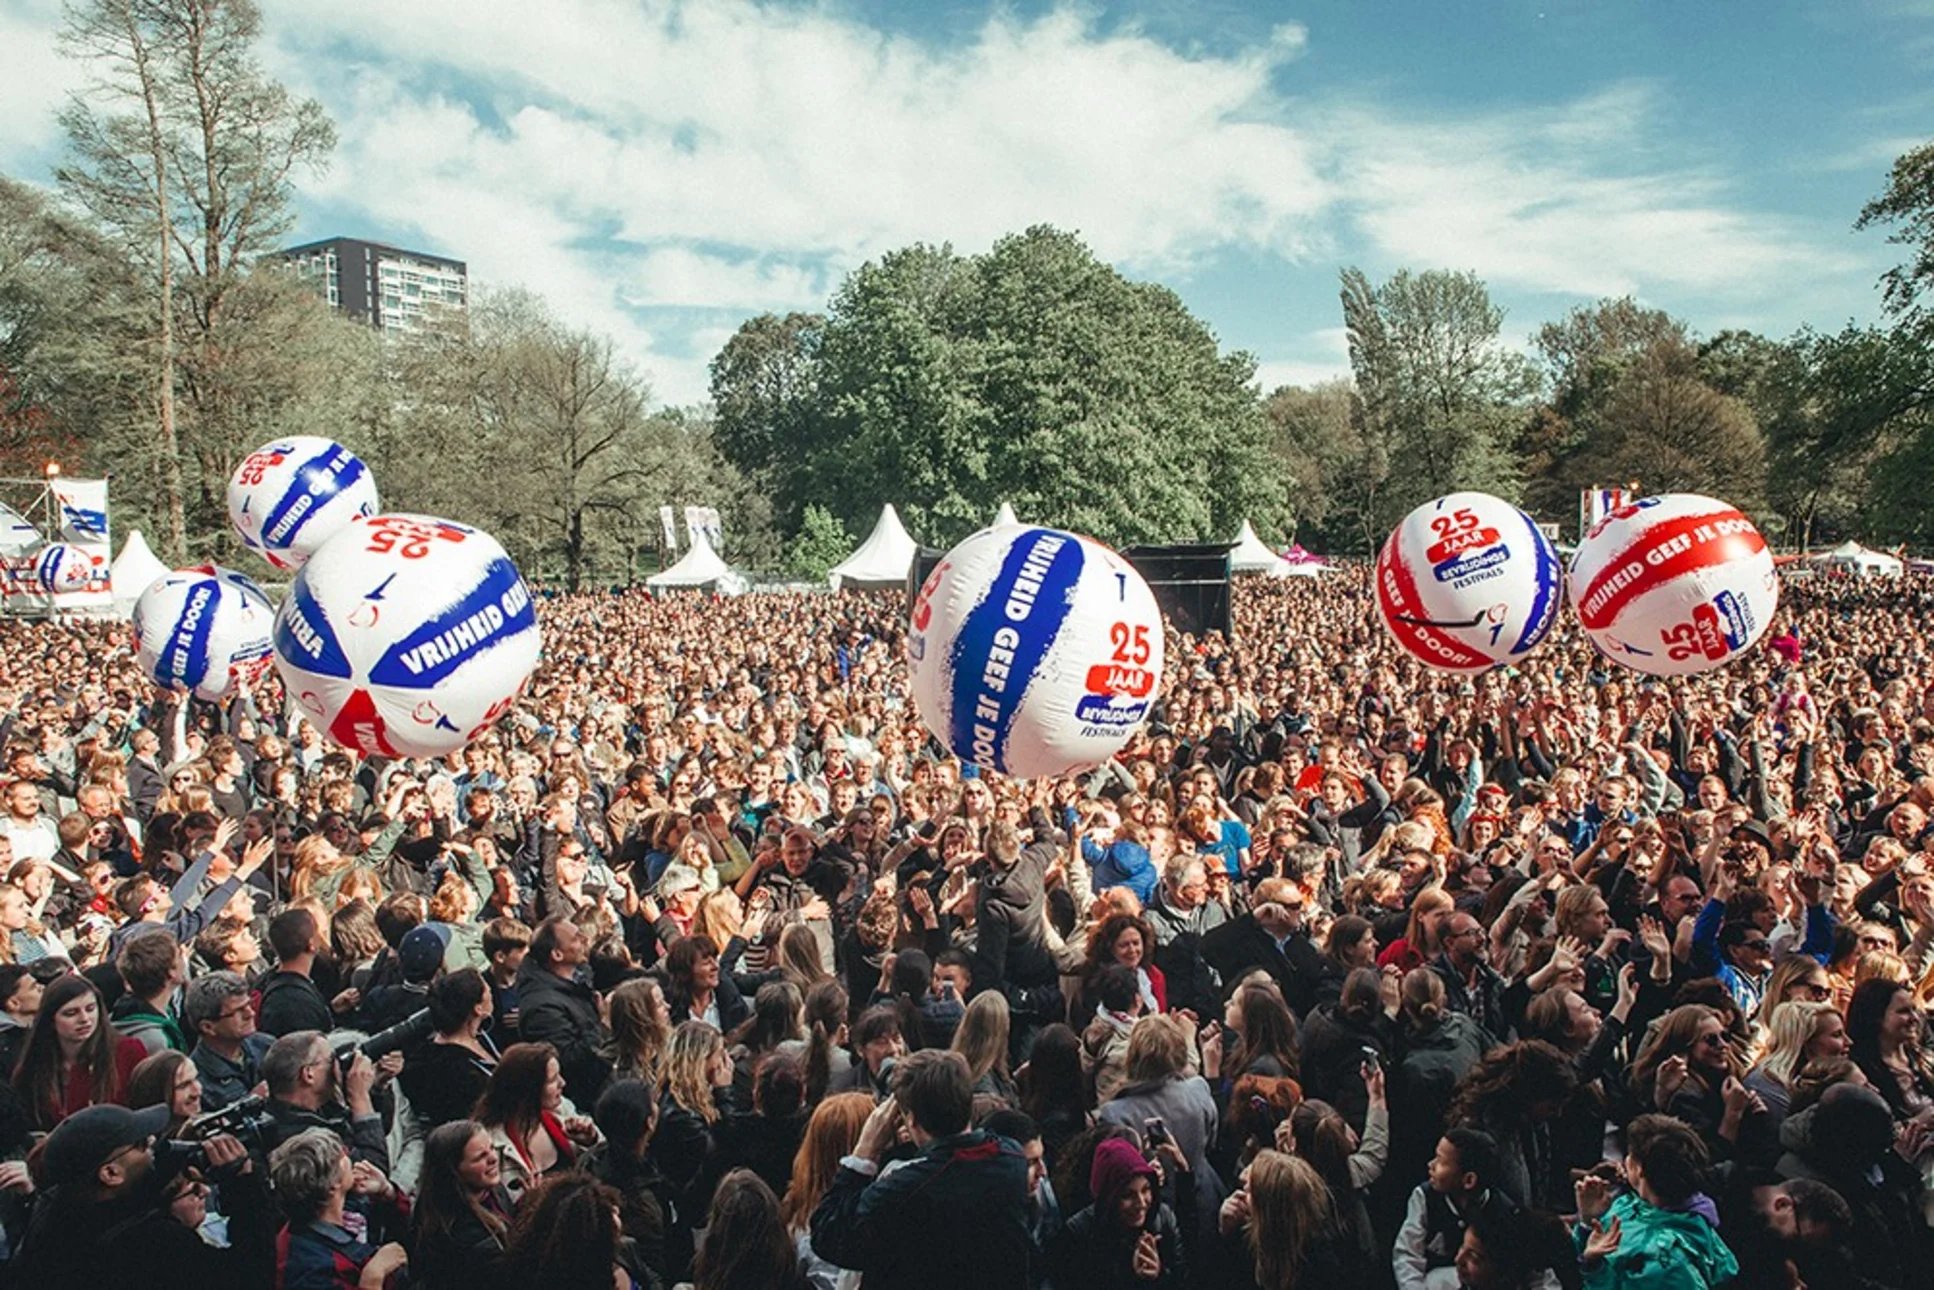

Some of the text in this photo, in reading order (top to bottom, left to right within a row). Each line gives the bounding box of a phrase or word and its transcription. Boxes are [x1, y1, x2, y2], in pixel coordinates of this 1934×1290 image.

[1431, 508, 1479, 538] 25
[366, 530, 430, 559] 25
[1443, 531, 1485, 554] JAAR
[1004, 534, 1067, 622] VRIJHEID
[1453, 568, 1504, 589] FESTIVALS
[1583, 561, 1645, 620] VRIJHEID
[1646, 533, 1693, 566] GEEF
[1694, 525, 1716, 544] JE
[1384, 569, 1405, 607] GEEF
[1414, 626, 1473, 665] DOOR!
[1697, 617, 1720, 650] JAAR
[399, 603, 504, 675] VRIJHEID
[1109, 620, 1151, 665] 25
[1660, 623, 1702, 661] 25
[171, 648, 189, 676] GEEF
[983, 627, 1020, 693] GEEF
[1104, 666, 1147, 691] JAAR
[976, 693, 1001, 723] JE
